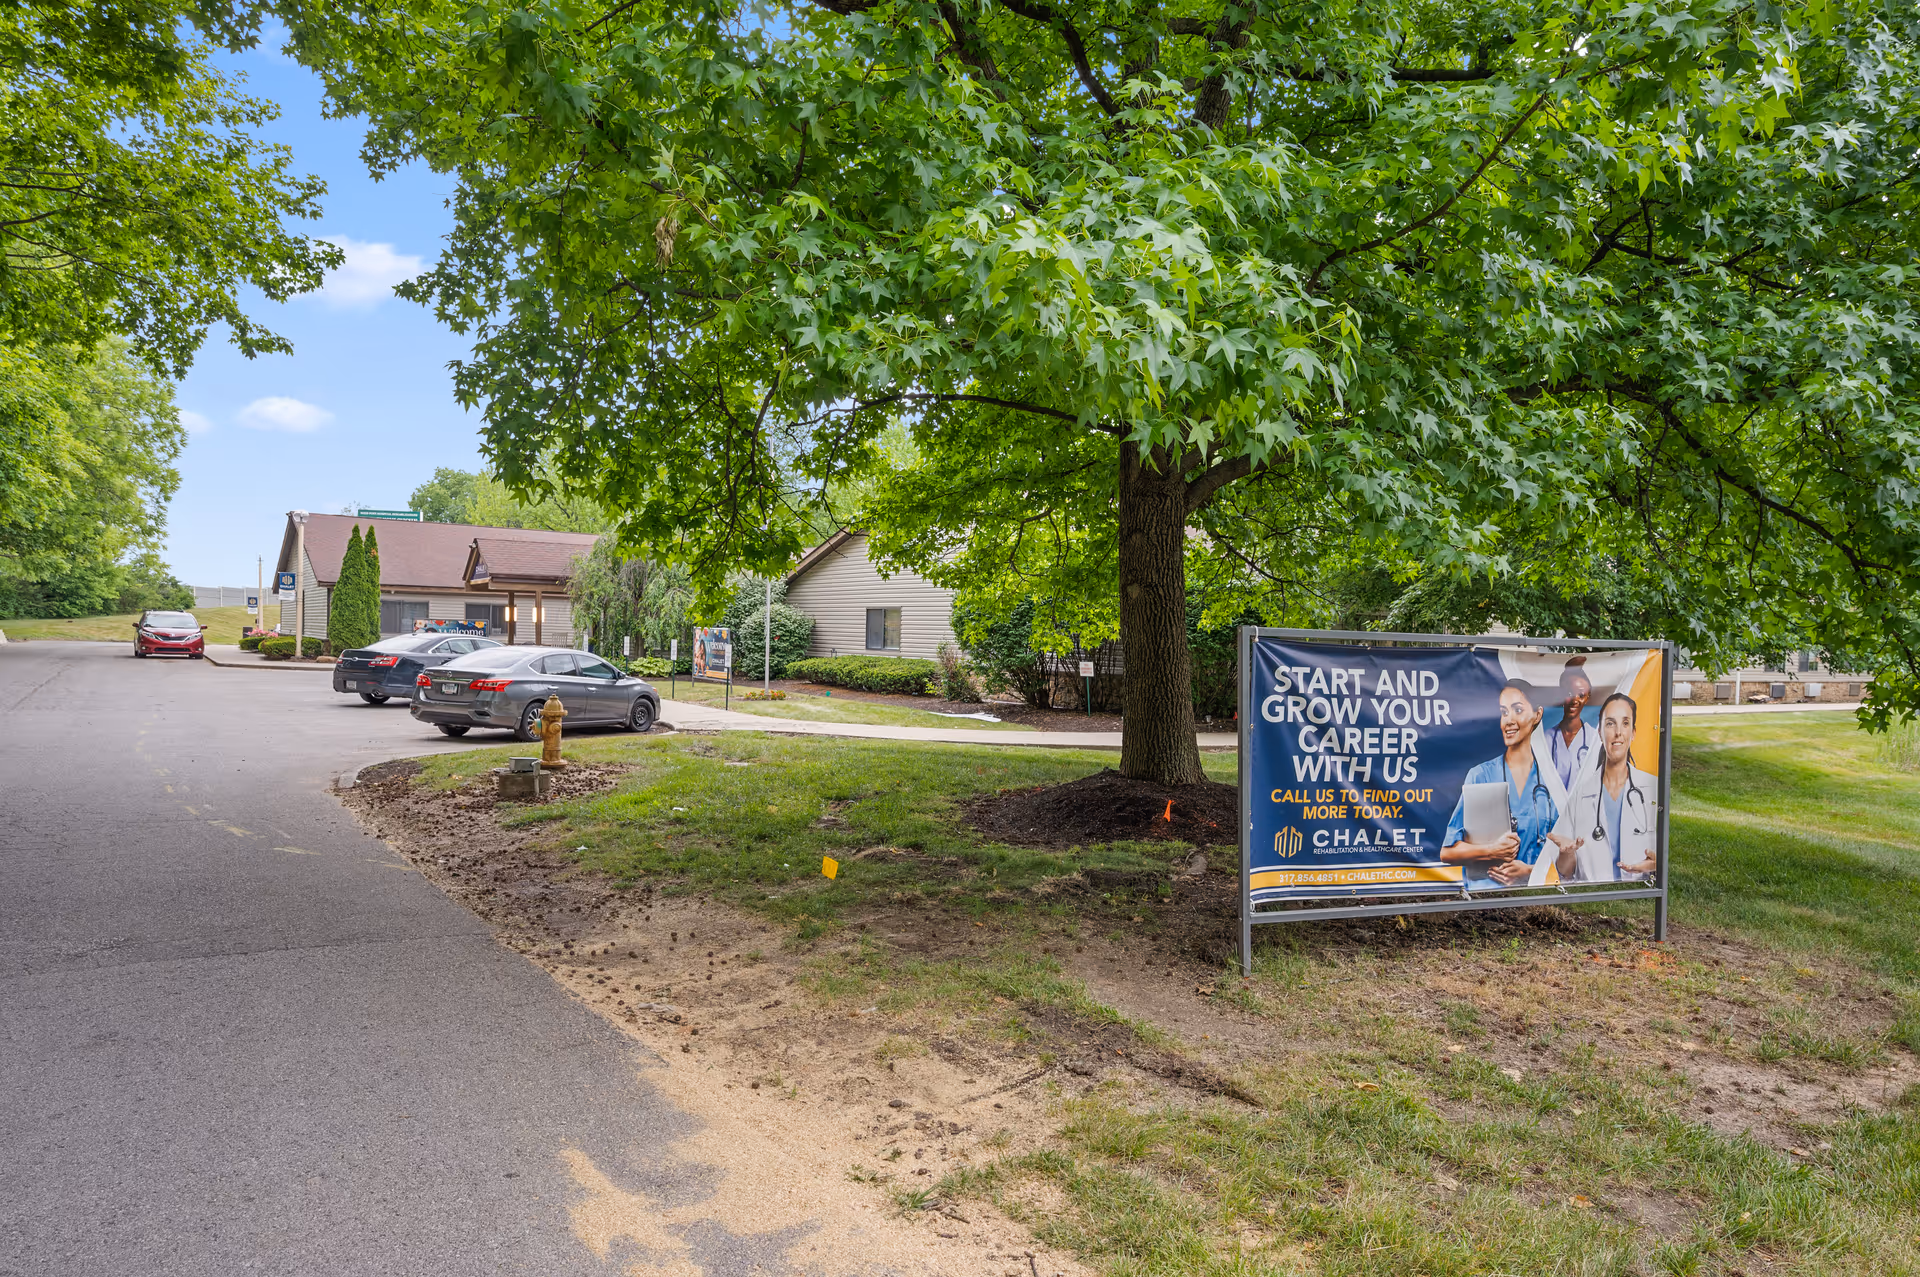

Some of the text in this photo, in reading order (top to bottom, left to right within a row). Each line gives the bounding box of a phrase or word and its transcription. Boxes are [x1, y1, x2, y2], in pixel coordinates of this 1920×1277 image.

[1273, 665, 1440, 697] START AND
[1261, 694, 1453, 726] GROW YOUR
[1298, 725, 1419, 755] CAREER
[1292, 755, 1419, 783] WITH US
[1270, 789, 1434, 804] CALL US TO FIND OUT
[1302, 805, 1404, 820] MORE TODAY.
[1312, 828, 1426, 847] CHALET
[1313, 847, 1358, 855] REHABILITATION
[1279, 870, 1416, 883] 317.856.4851 CHALETHC.COM
